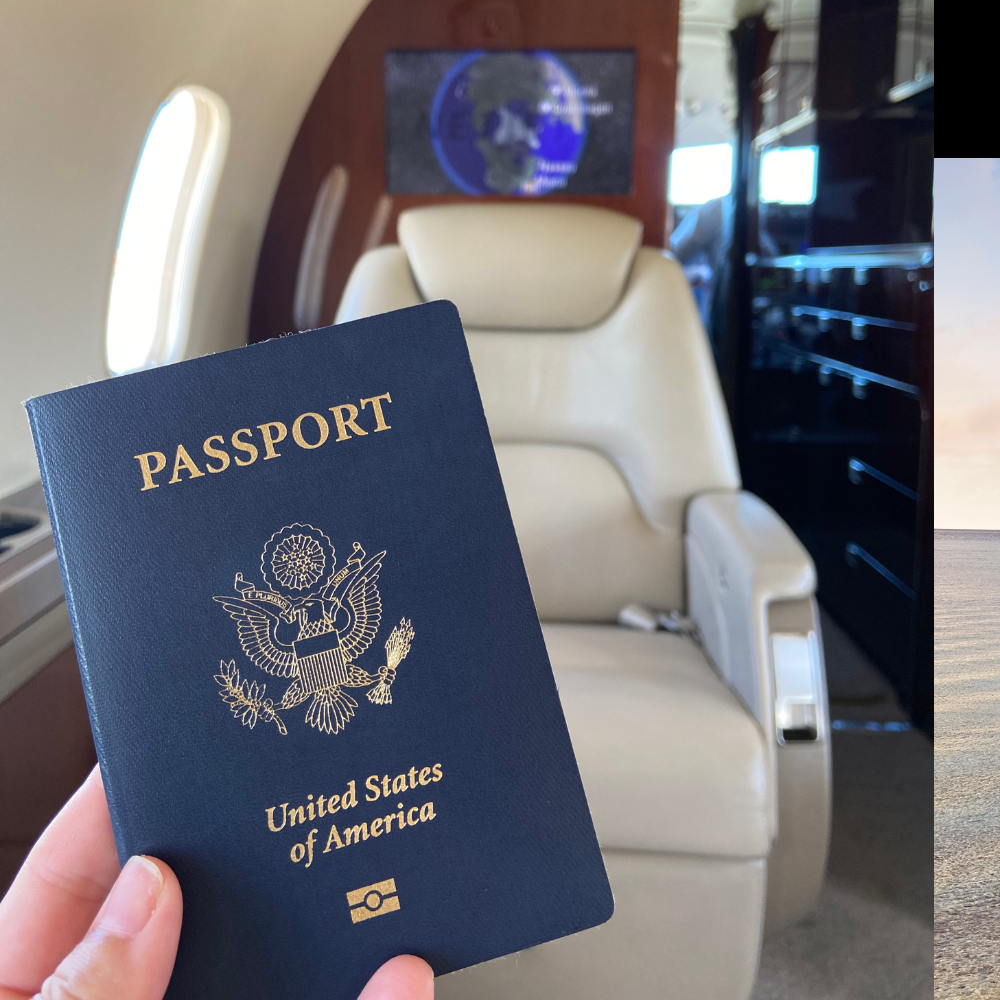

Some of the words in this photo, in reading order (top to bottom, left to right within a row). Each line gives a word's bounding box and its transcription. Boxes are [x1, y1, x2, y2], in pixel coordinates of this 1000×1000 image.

[134, 392, 392, 491] PASSPORT
[265, 780, 358, 832] United
[365, 763, 443, 802] States
[290, 828, 319, 868] of
[322, 801, 437, 854] America
